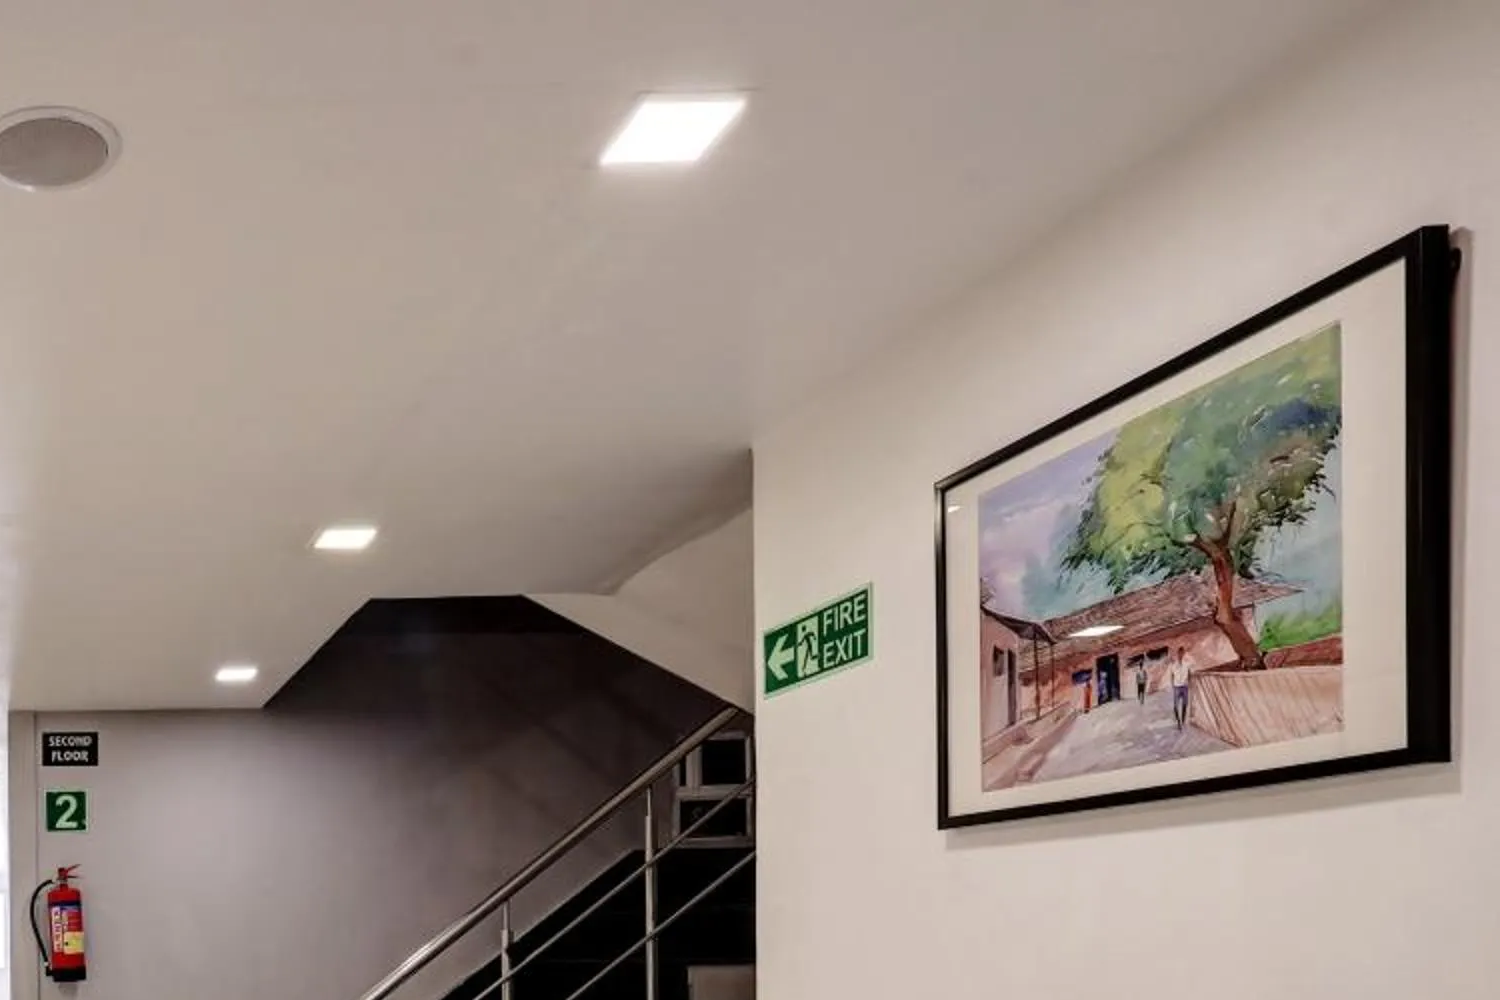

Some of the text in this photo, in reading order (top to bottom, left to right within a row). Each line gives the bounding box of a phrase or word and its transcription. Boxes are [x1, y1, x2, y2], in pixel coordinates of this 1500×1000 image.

[823, 593, 866, 636] FIRE
[823, 628, 866, 668] EXIT
[48, 735, 93, 747] SECOND
[51, 750, 89, 763] FLOOR
[55, 794, 78, 829] 2
